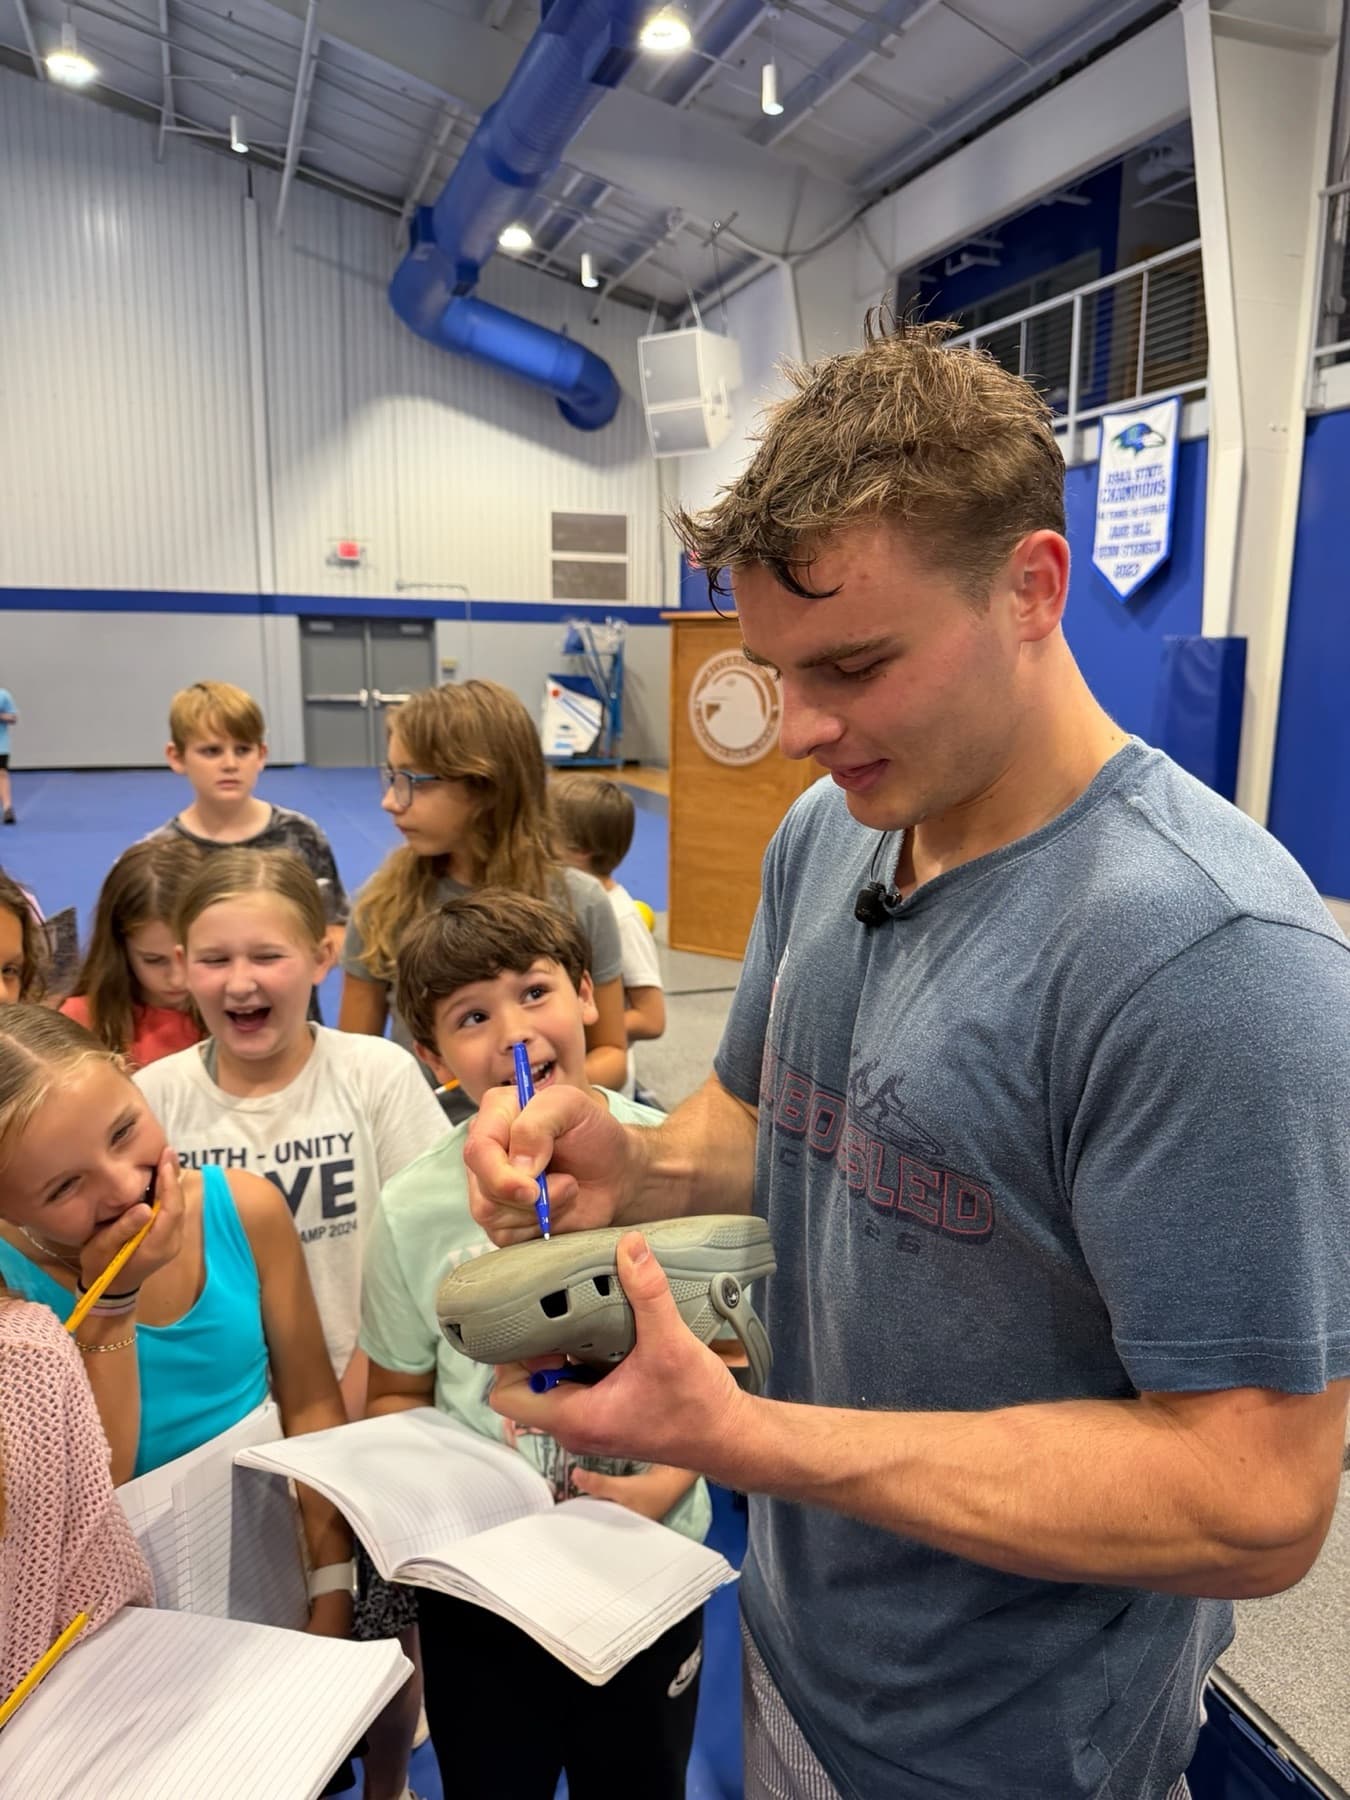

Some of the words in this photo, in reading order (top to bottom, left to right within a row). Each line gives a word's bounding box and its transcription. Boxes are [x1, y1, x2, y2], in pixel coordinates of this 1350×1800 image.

[178, 1147, 247, 1170] RUTH
[274, 1131, 354, 1164] UNITY
[264, 1159, 357, 1219] VE
[299, 1226, 326, 1243] AMP
[329, 1220, 357, 1238] 2024
